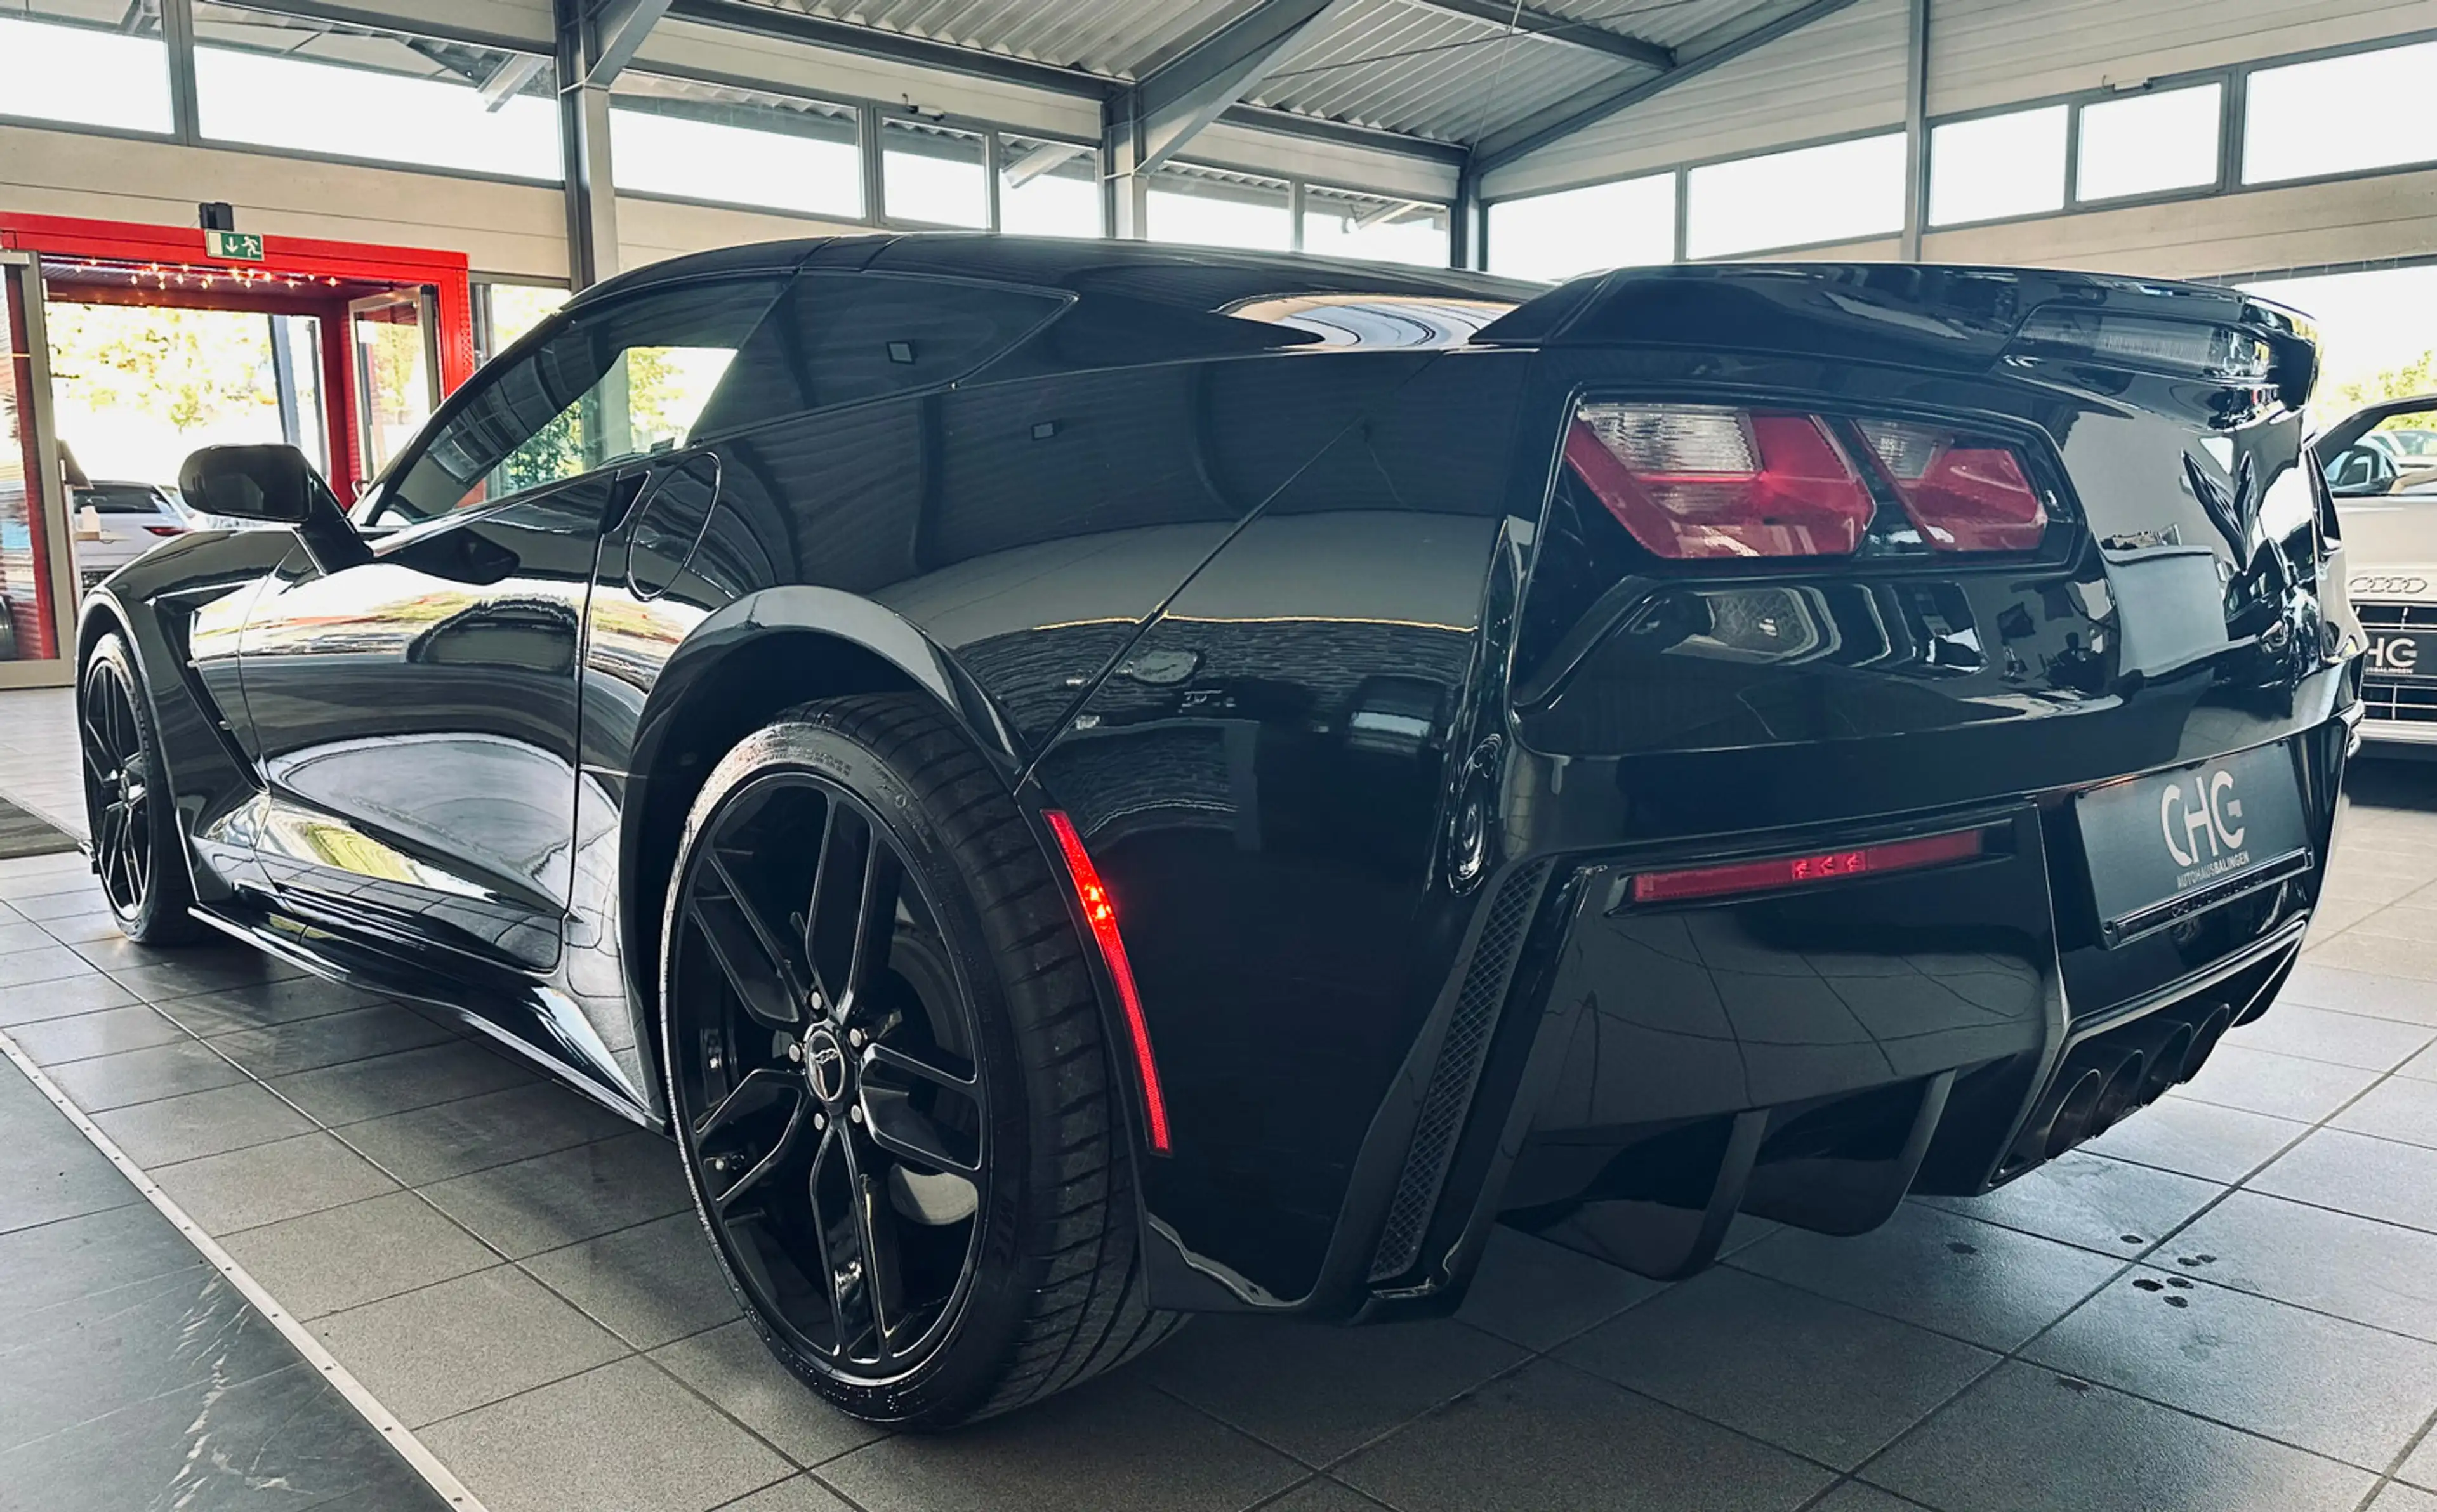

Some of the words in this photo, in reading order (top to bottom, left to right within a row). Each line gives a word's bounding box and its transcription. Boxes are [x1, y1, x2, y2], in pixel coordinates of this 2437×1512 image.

[2368, 638, 2417, 667] HG
[2161, 770, 2245, 867] CHG
[2177, 851, 2250, 890] AUTOHAUSBALINGEN
